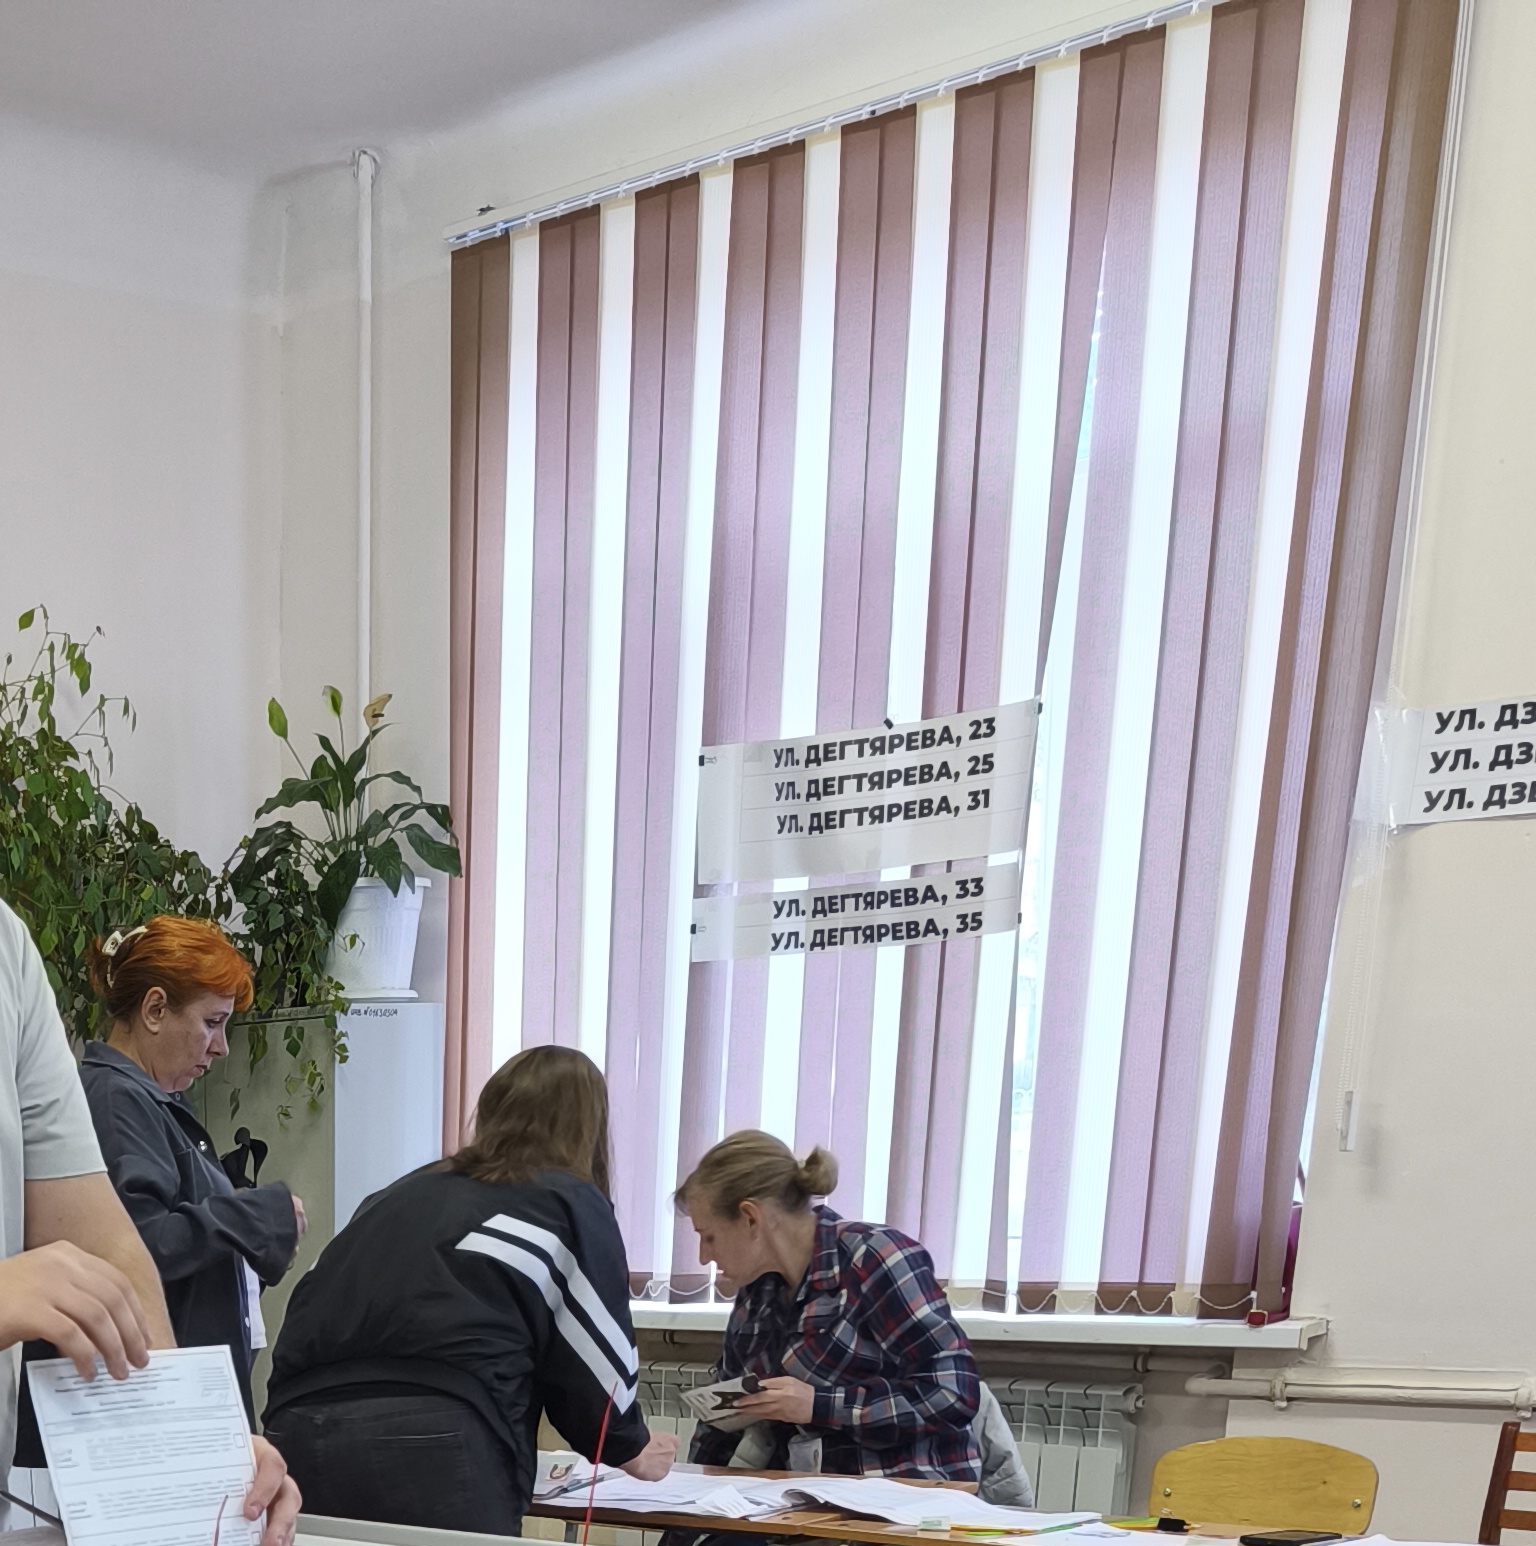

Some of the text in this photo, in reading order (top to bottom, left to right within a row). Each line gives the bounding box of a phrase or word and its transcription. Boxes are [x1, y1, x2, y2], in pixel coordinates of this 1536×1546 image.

[1434, 707, 1486, 735] УЛ.
[773, 716, 997, 769] УЛ. ДЕГТЯРЕВА, 23
[1428, 741, 1536, 774] УЛ. ДЗ
[774, 753, 995, 802] УЛ. ДЕГТЯРЕВА, 25
[776, 788, 991, 835] УЛ. ДЕГТЯРЕВА, 31
[1422, 787, 1474, 813] УЛ.
[772, 876, 984, 919] УЛ. ДЕГТЯРЕВА, 33
[770, 911, 983, 951] УЛ. ДЕГТЯРЕВА, 35
